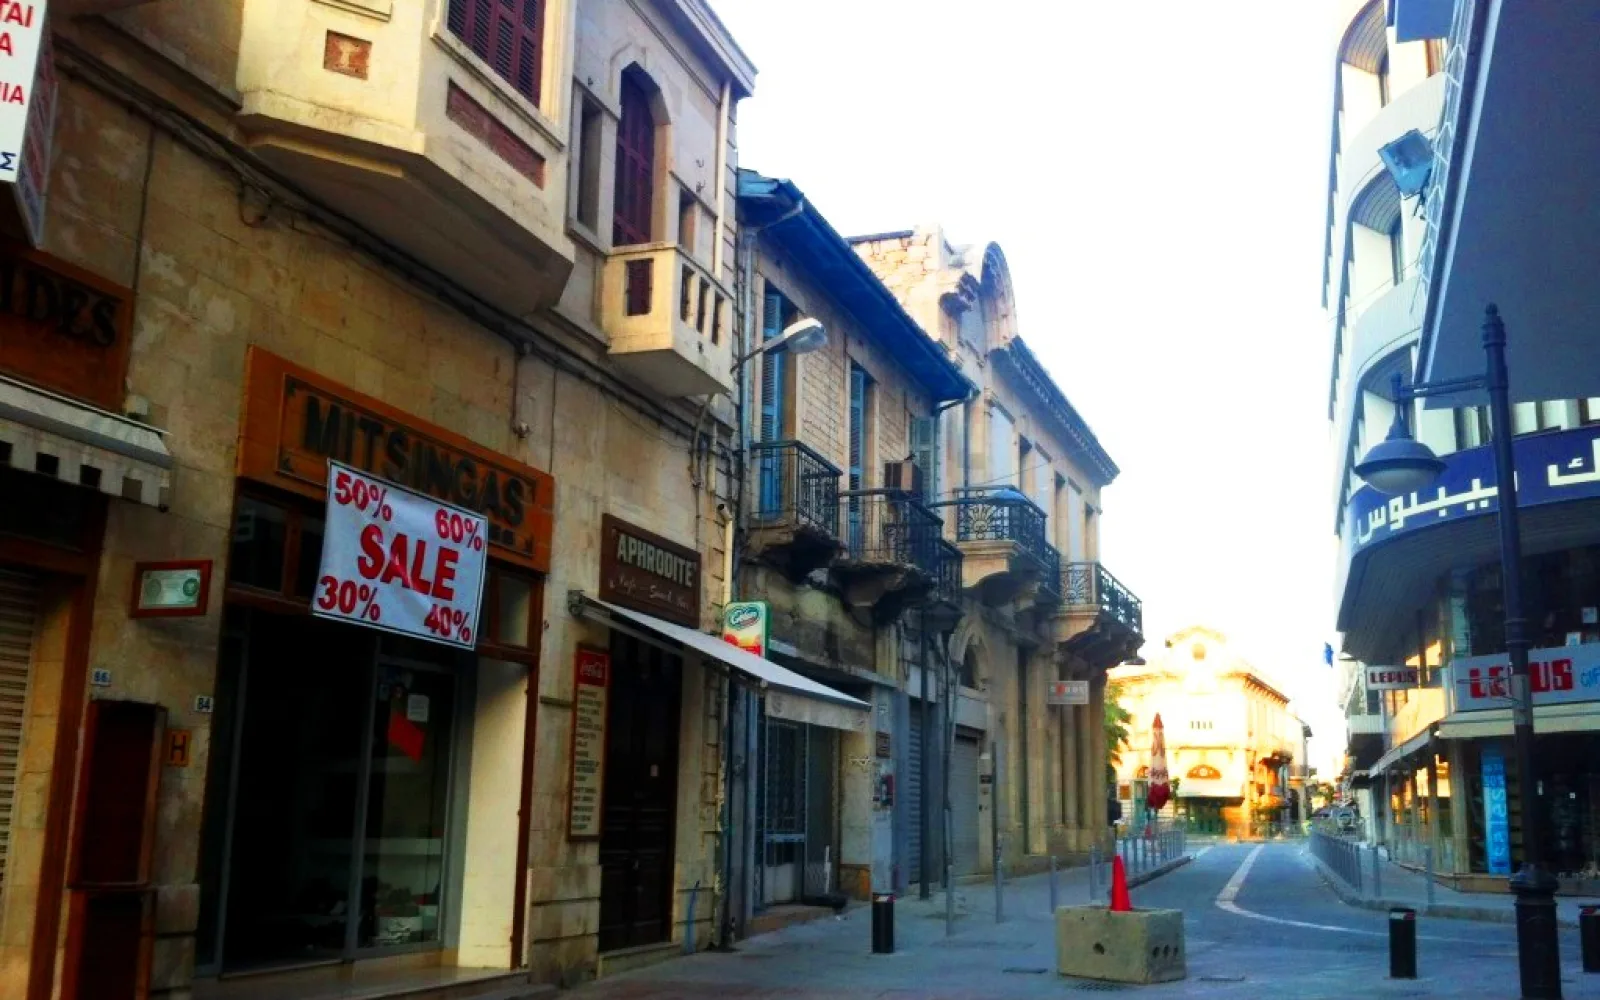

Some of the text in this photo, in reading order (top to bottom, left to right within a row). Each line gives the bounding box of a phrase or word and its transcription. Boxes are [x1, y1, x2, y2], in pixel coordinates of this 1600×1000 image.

[0, 81, 25, 106] ΙΑ
[303, 395, 526, 528] MITSINGAS
[335, 470, 392, 522] 50%
[435, 508, 482, 551] 60%
[357, 523, 459, 602] SALE
[617, 532, 694, 588] APHRODITE
[317, 575, 380, 622] 30%
[424, 603, 472, 642] 40%
[1369, 671, 1417, 685] LEPUS
[1469, 658, 1573, 699] LEUS
